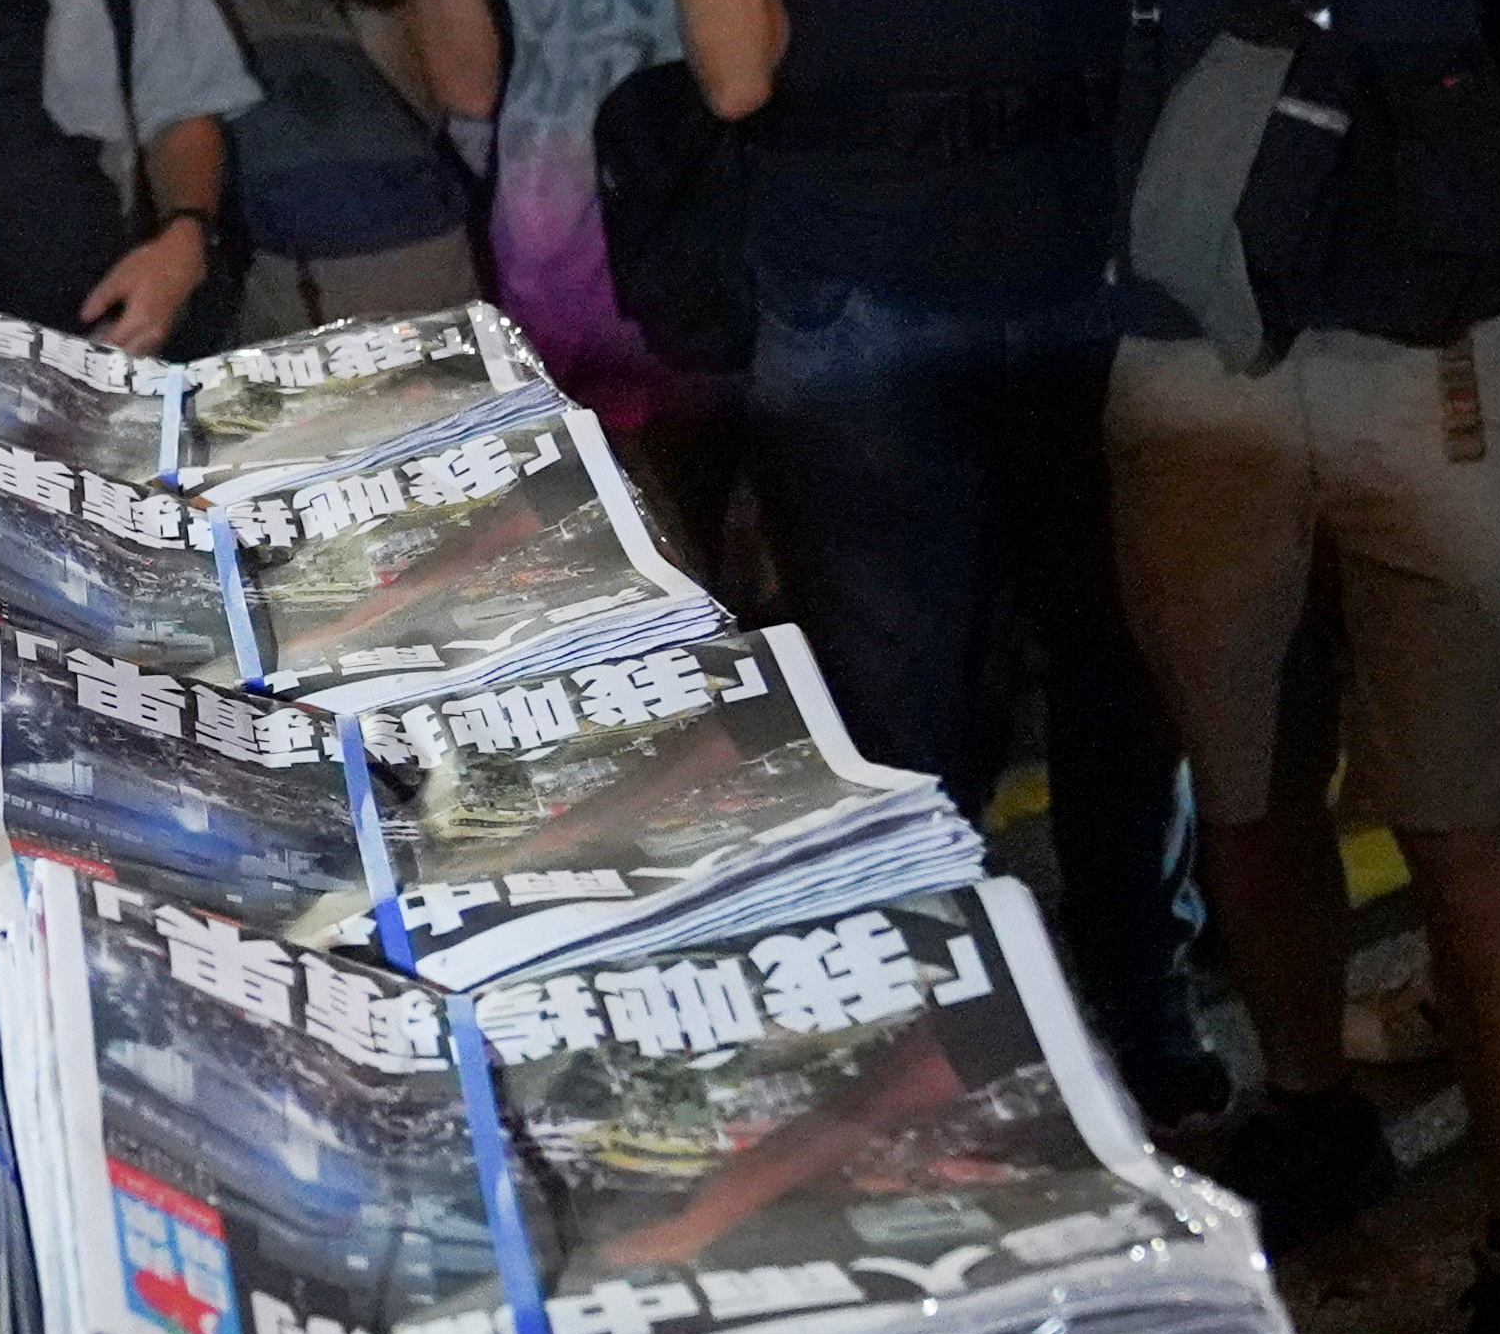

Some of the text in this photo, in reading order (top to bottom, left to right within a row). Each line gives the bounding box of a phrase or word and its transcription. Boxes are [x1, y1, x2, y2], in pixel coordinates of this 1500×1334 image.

[94, 881, 994, 1077] 「我哋撐蘋果」
